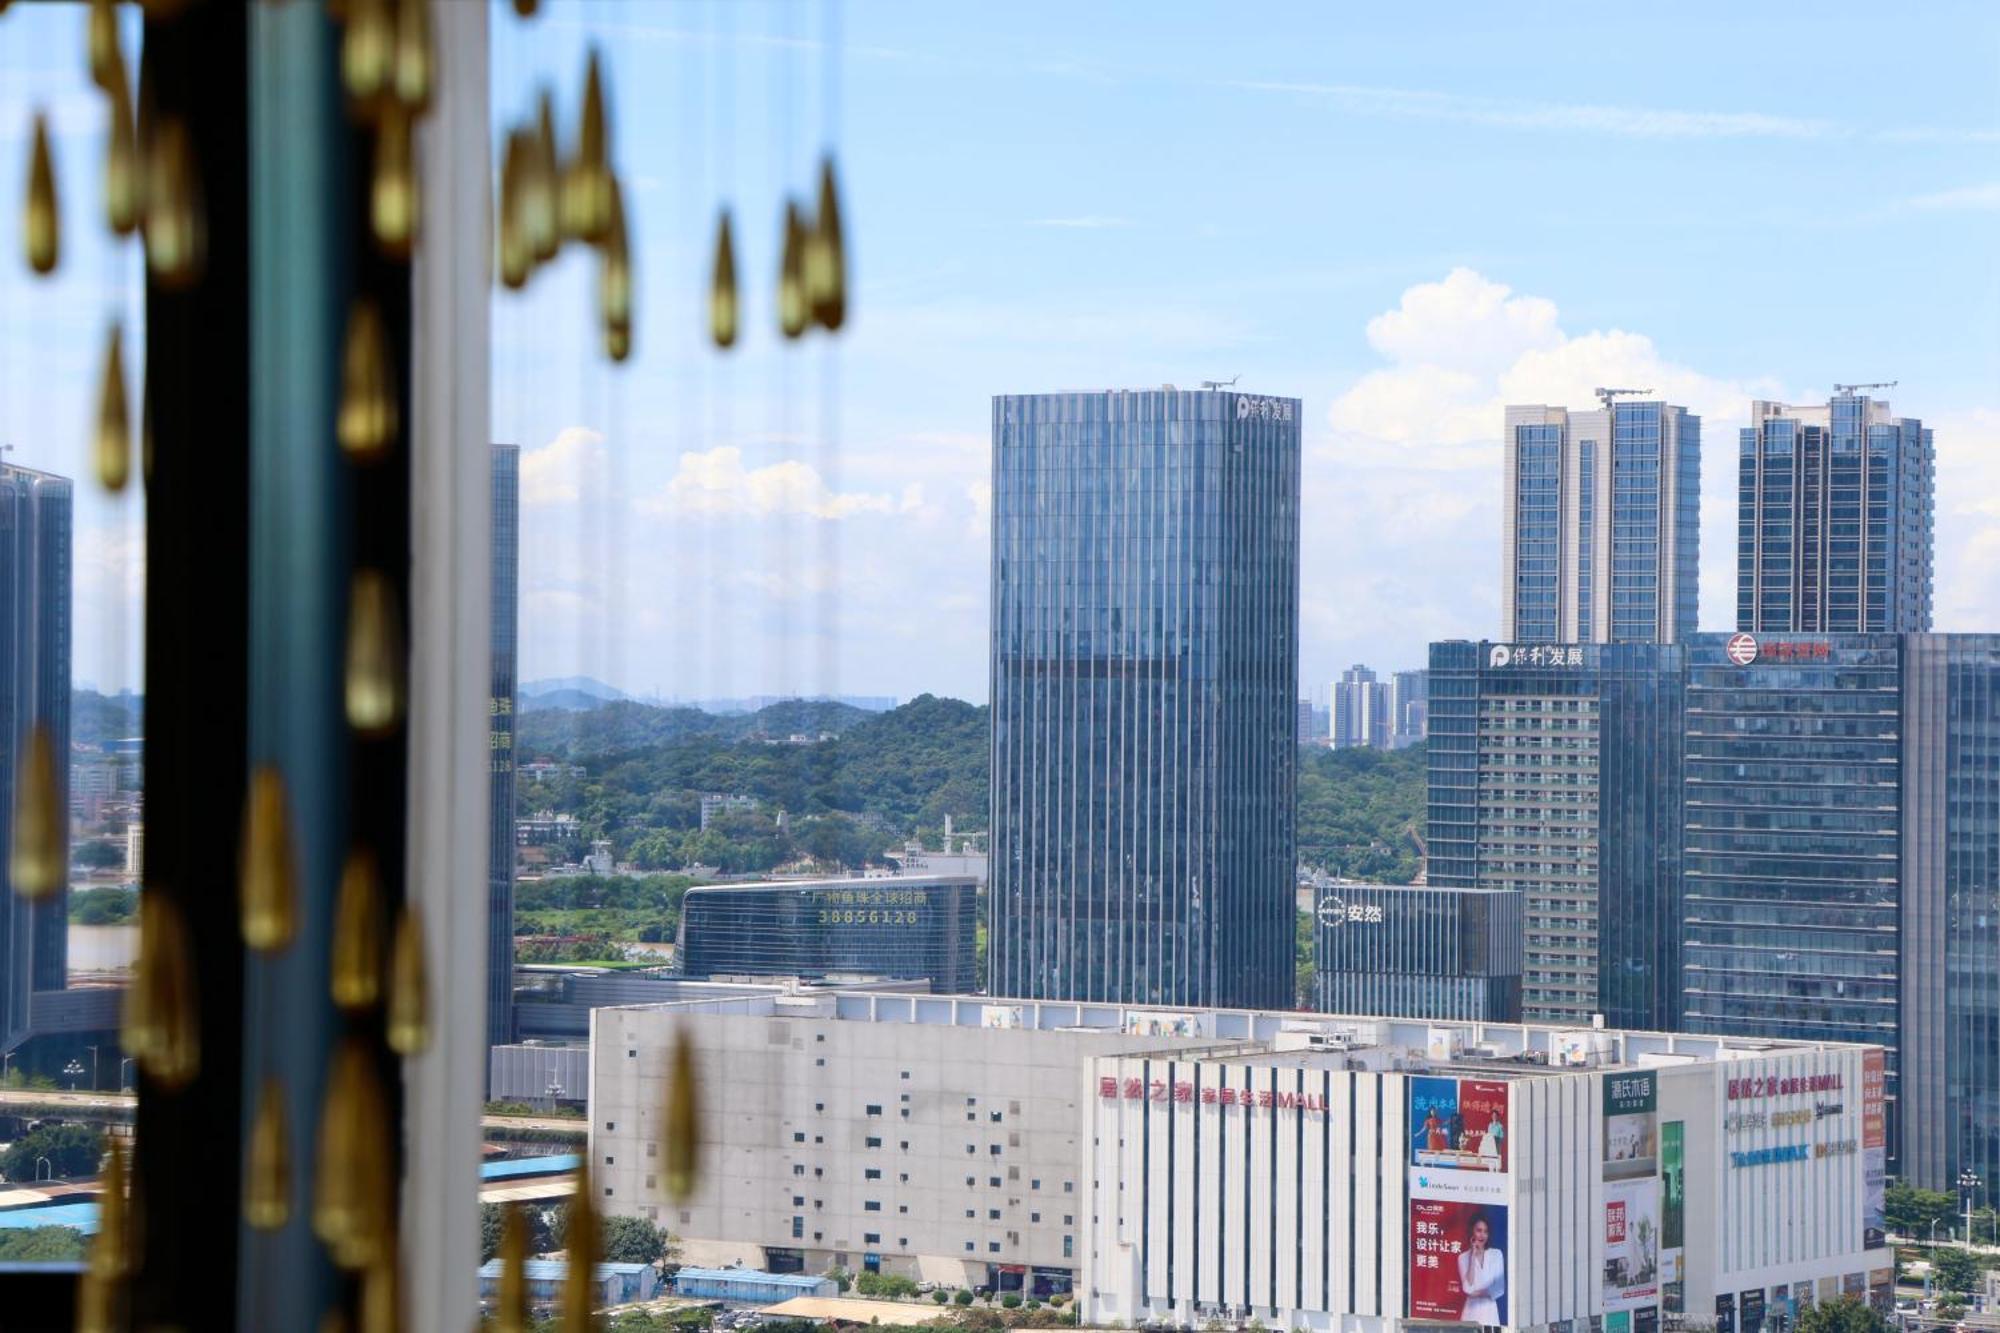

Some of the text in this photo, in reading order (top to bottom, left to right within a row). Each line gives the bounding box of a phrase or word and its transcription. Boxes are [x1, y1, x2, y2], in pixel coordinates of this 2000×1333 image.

[1513, 646, 1583, 667] 保利发展
[818, 910, 917, 924] 38856128
[1347, 904, 1382, 923] 安然
[1612, 1077, 1650, 1099] 源氏木语
[1416, 1237, 1462, 1253] 设计让家
[1416, 1254, 1439, 1269] 更美
